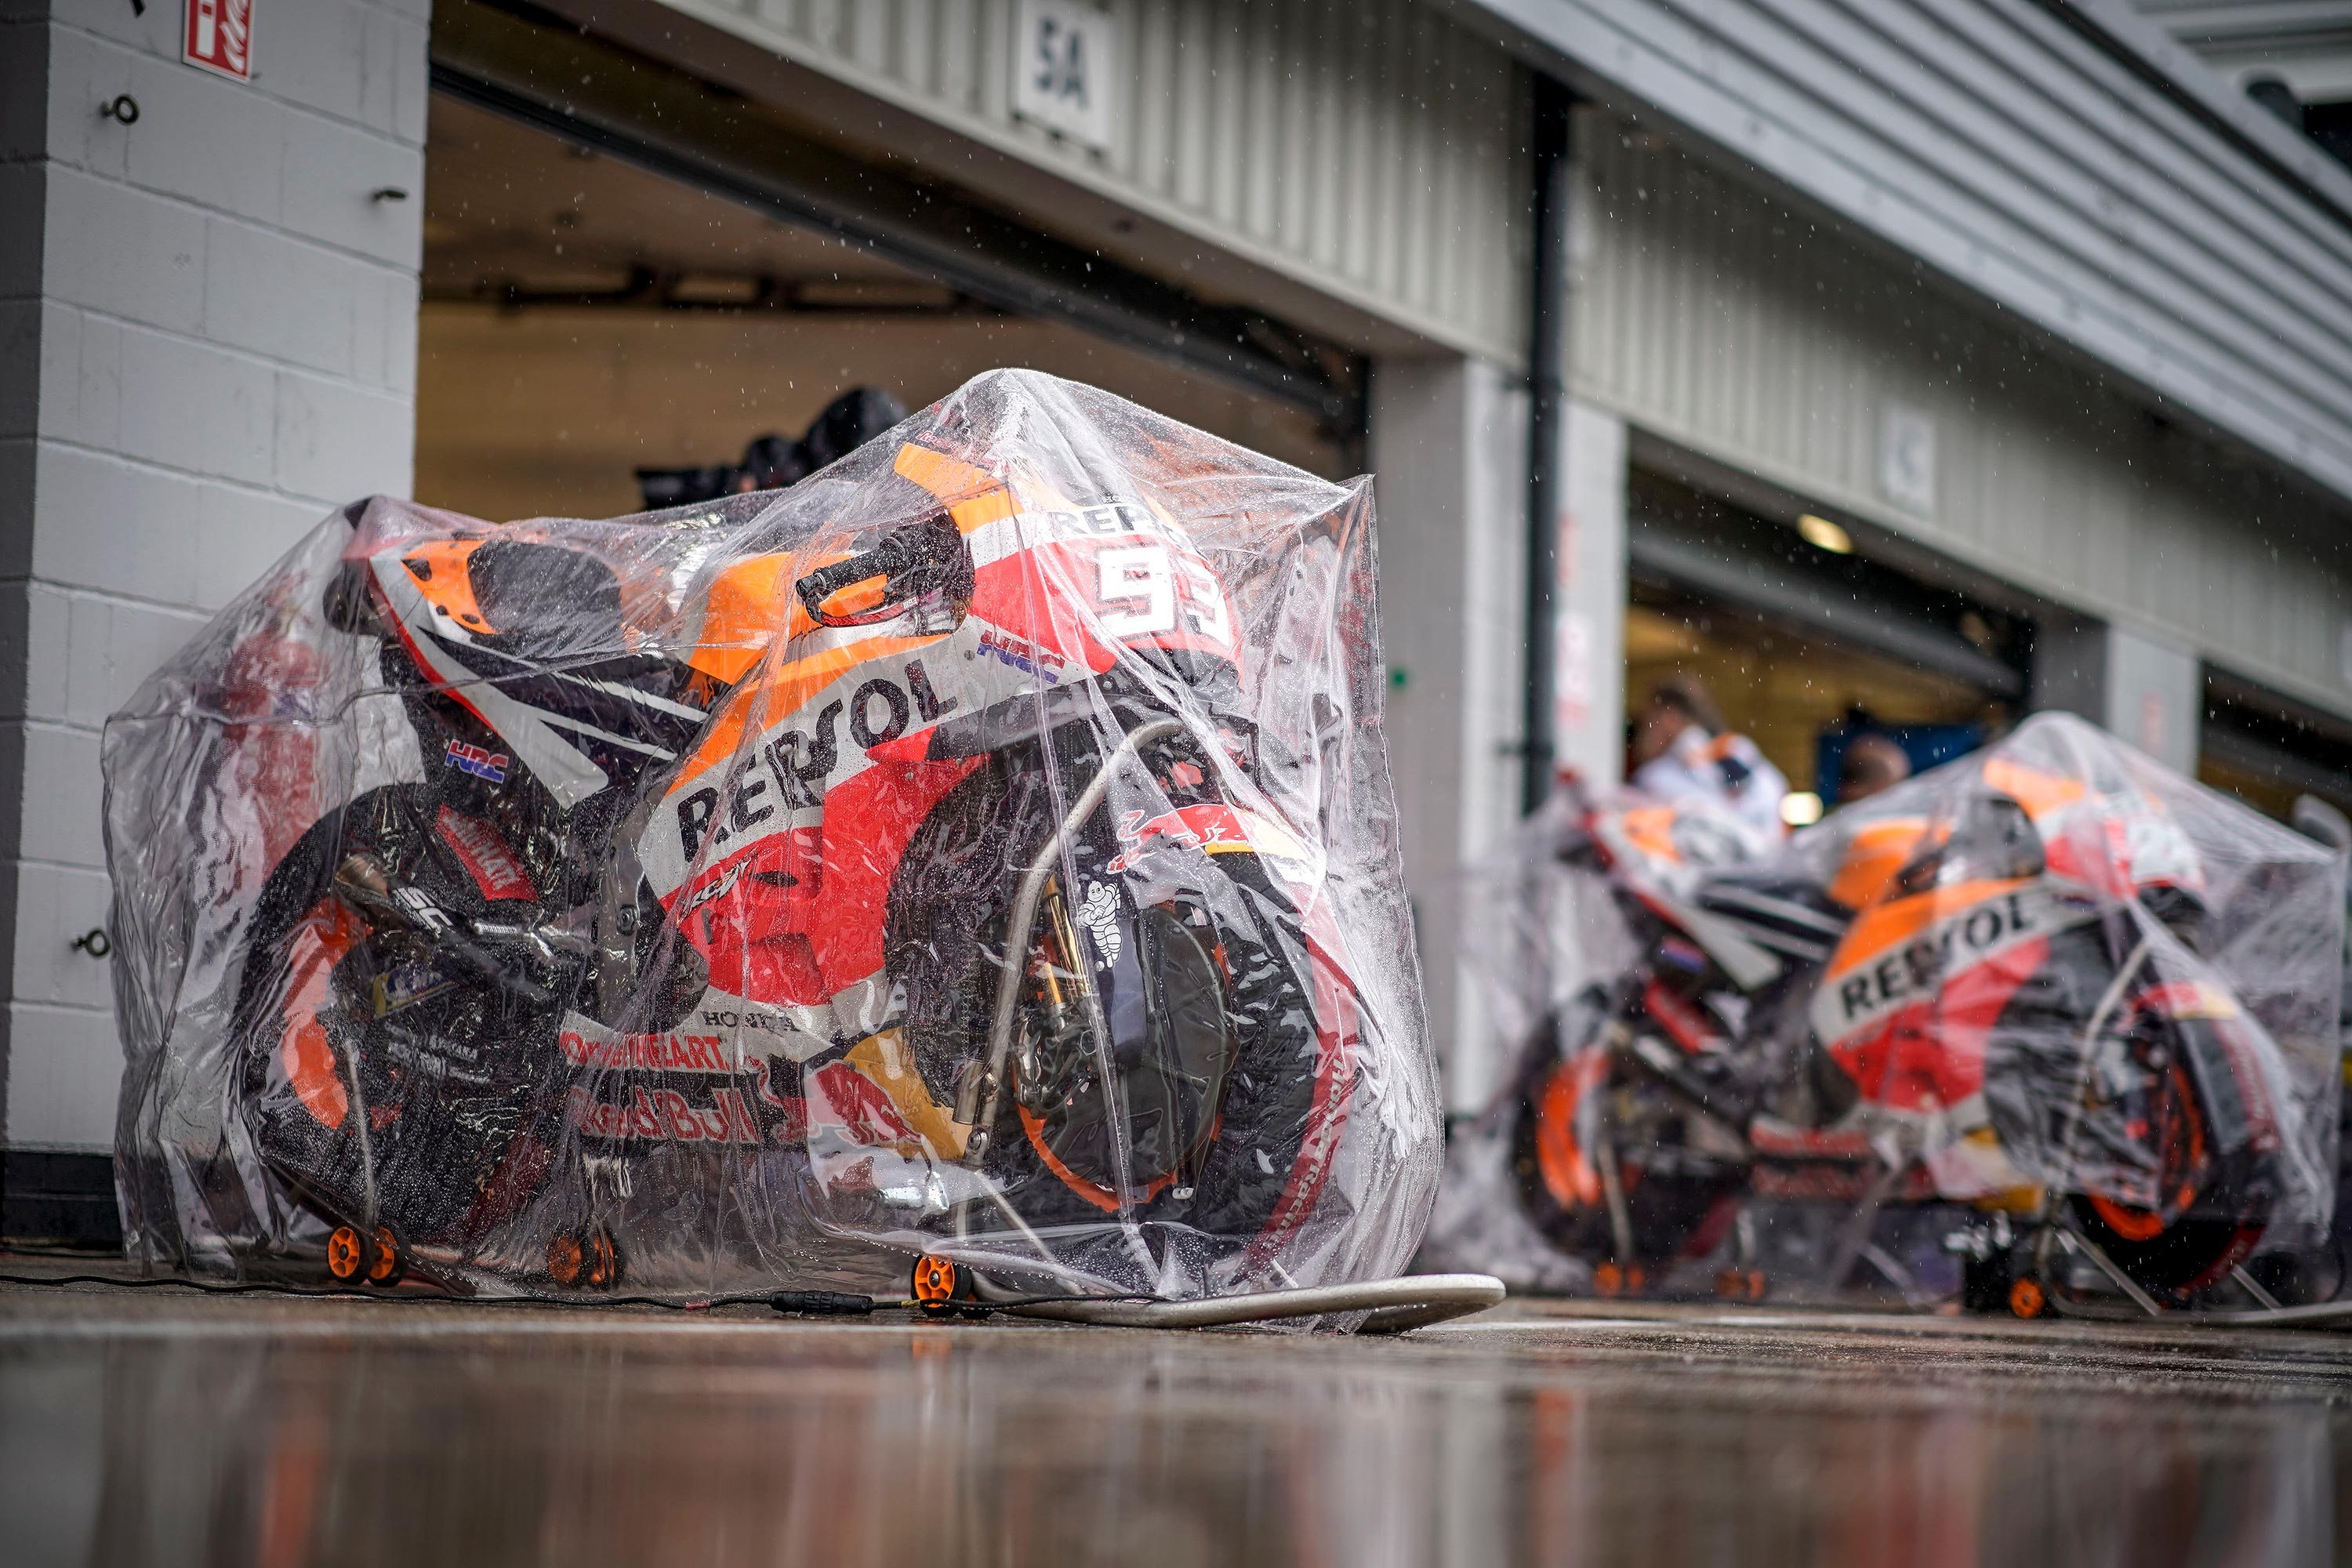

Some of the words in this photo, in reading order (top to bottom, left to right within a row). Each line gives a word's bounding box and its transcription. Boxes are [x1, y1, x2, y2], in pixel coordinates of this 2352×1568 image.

[1096, 544, 1233, 648] 93
[976, 629, 1065, 684] HRC
[445, 739, 509, 784] HRC
[677, 658, 958, 862] REPSOL
[652, 1088, 759, 1144] Bull
